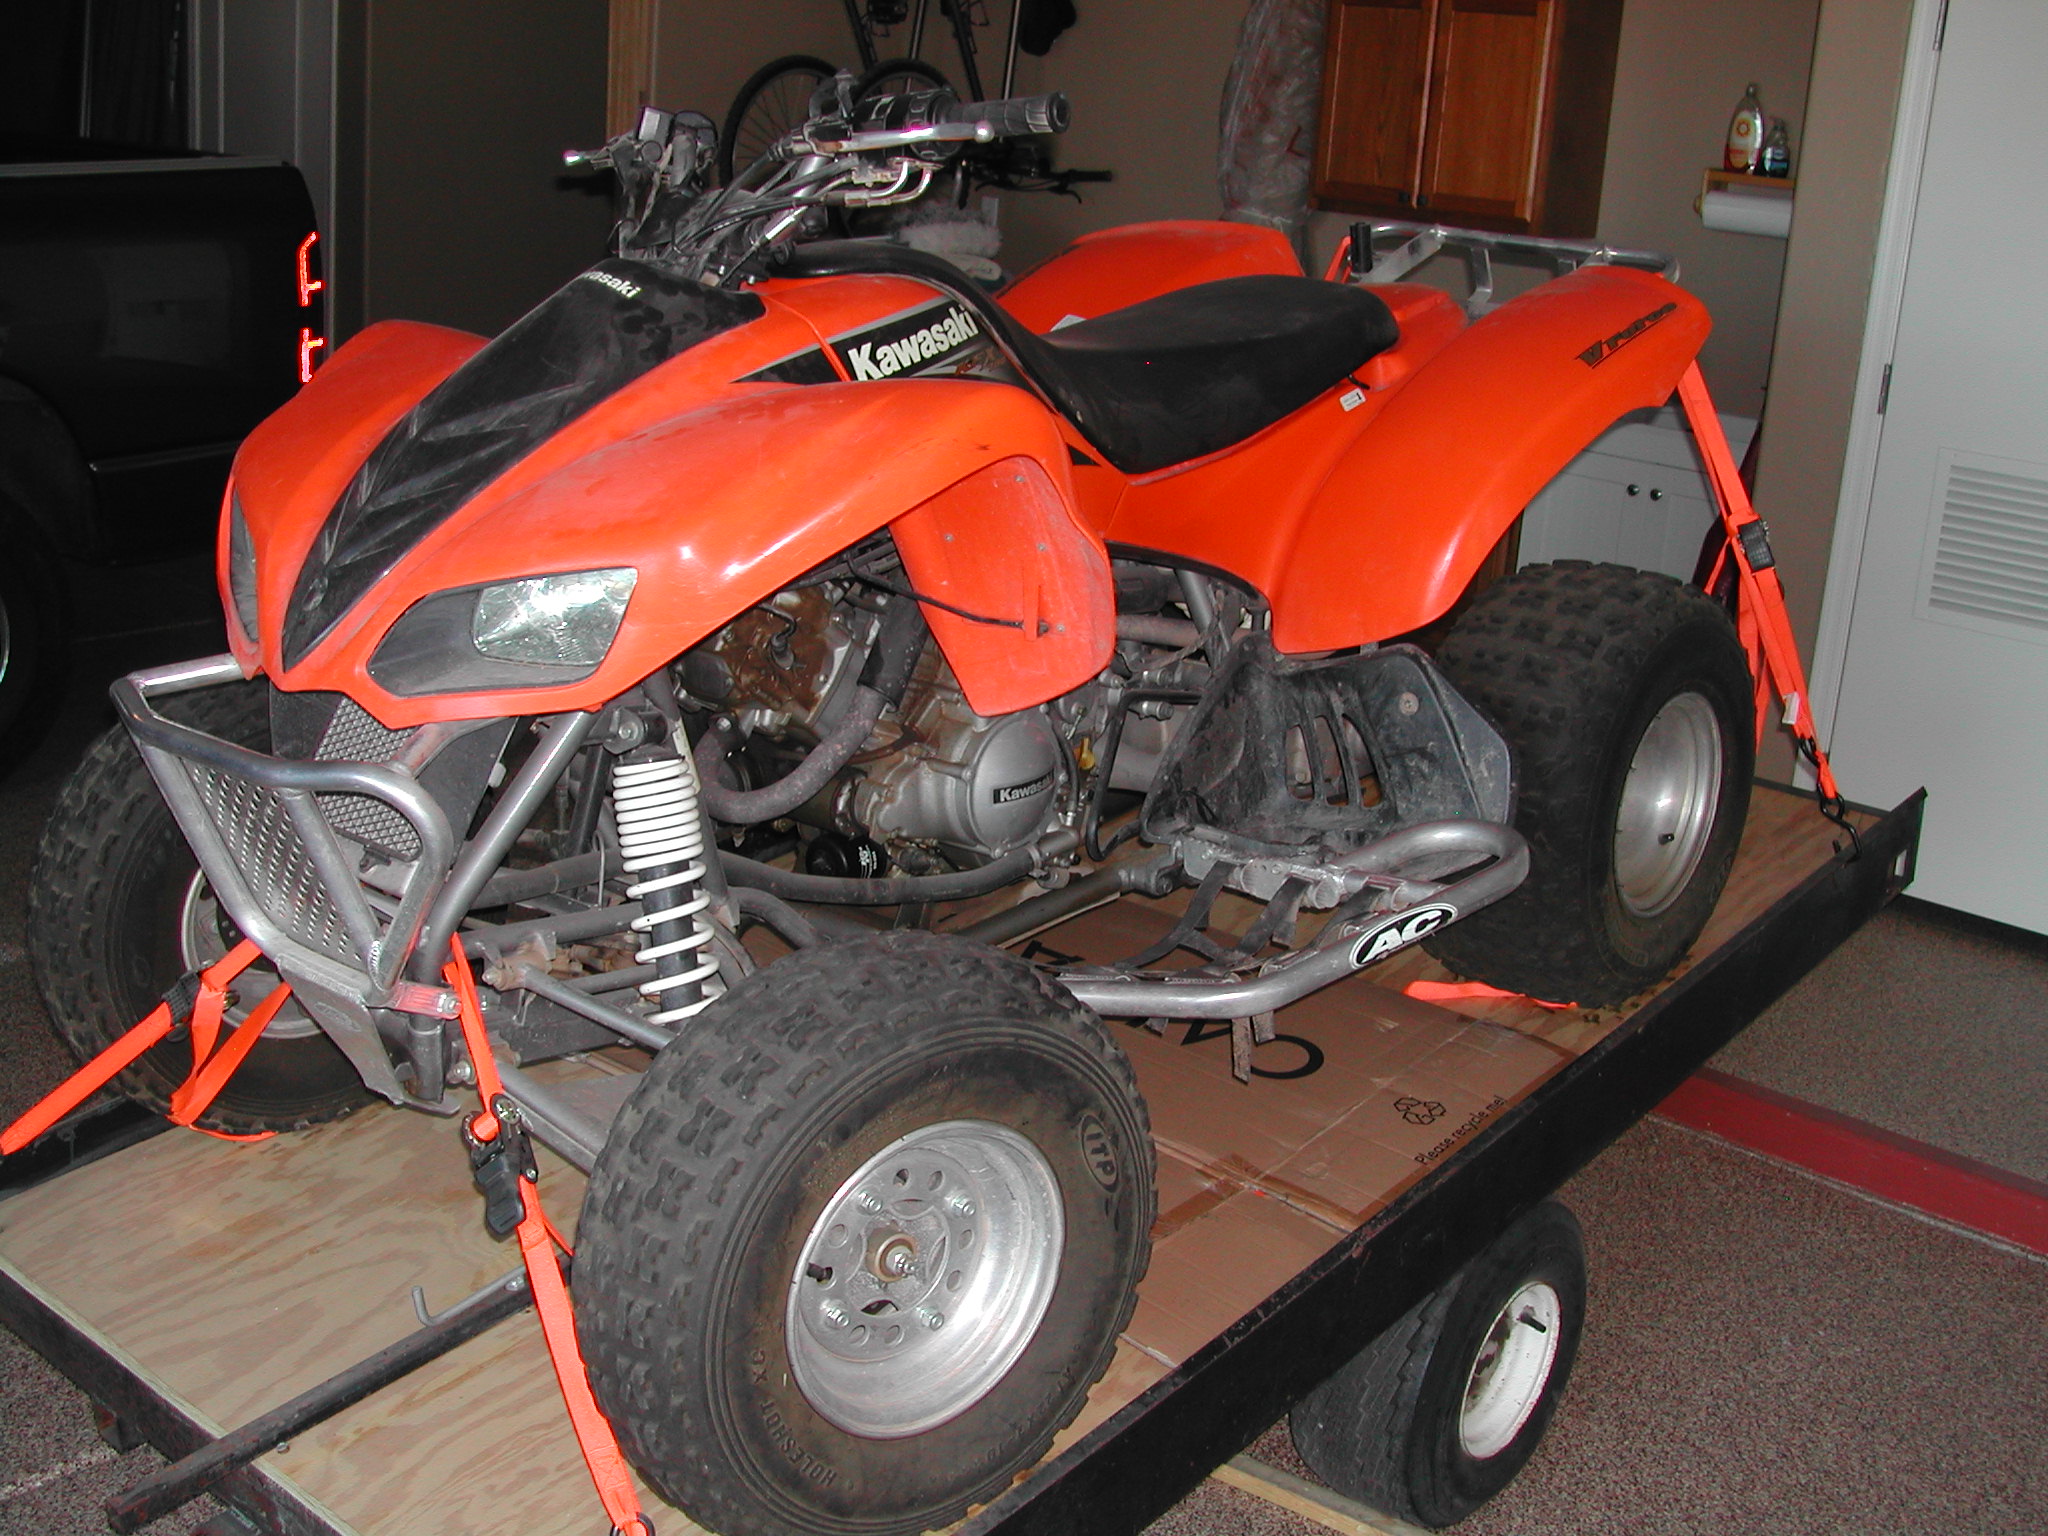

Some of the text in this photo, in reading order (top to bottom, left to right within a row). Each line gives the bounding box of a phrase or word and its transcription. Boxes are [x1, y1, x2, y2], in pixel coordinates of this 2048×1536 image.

[848, 304, 979, 382] Kawasaki
[1360, 909, 1442, 963] AC
[1086, 1131, 1116, 1176] ITP
[1415, 1137, 1455, 1166] Please
[1452, 1112, 1489, 1141] recycle
[760, 1400, 837, 1487] HOLESHOT
